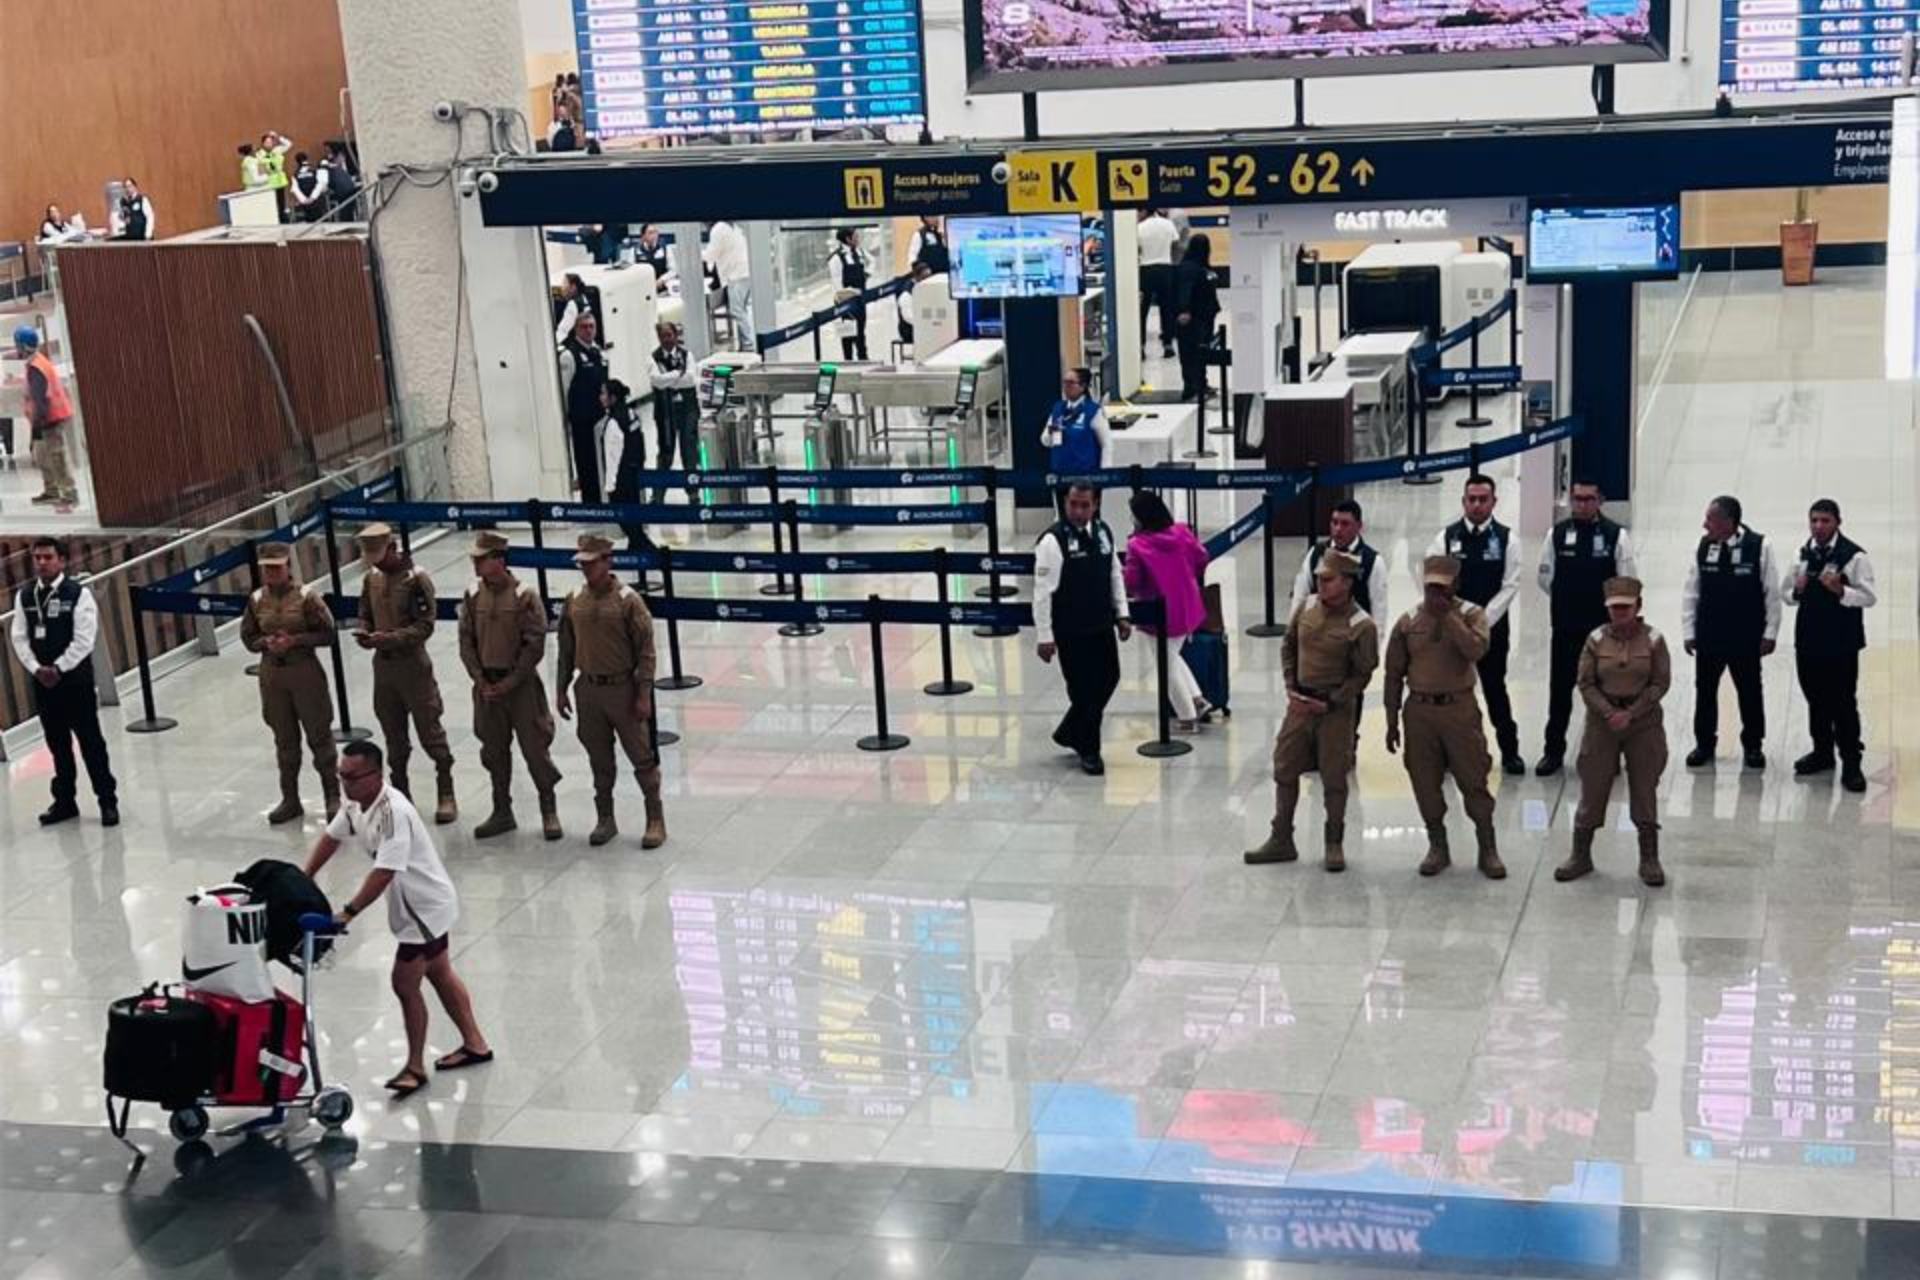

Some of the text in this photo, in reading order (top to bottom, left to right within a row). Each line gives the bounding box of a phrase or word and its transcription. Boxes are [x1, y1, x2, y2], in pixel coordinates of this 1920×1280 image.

[1836, 129, 1876, 141] Acceso
[1835, 147, 1843, 161] y
[894, 171, 981, 188] Acceso Pasajeros
[1159, 164, 1196, 178] Puerta
[1207, 151, 1341, 198] 52 - 62
[1018, 161, 1078, 203] Sala K
[1335, 208, 1448, 231] FAST TRACK
